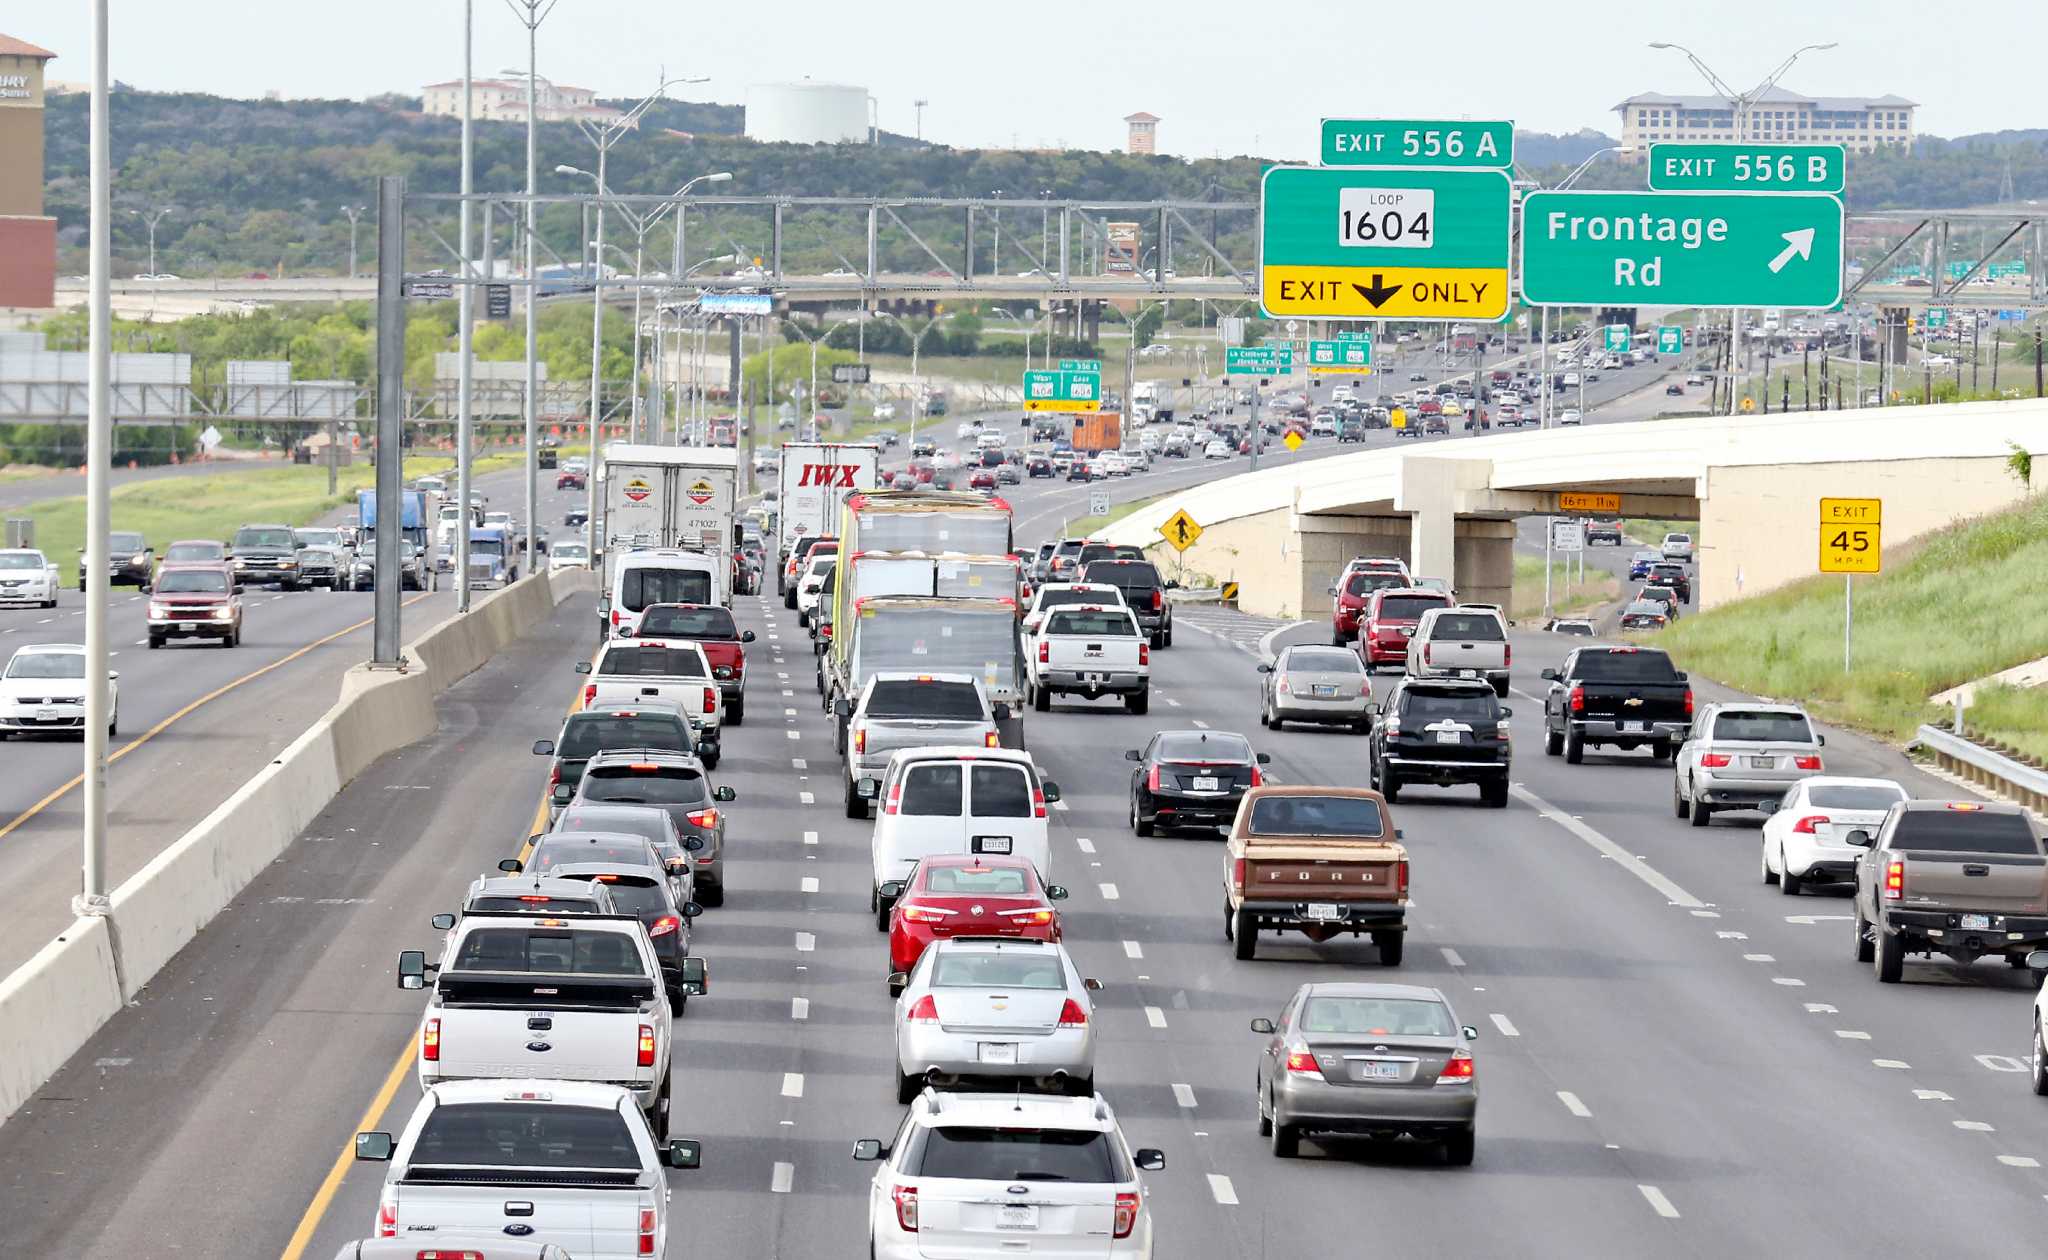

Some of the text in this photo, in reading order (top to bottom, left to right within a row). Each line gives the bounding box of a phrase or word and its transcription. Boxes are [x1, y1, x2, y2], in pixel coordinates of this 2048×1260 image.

[1335, 130, 1498, 158] EXIT 556 A
[1665, 155, 1828, 182] EXIT 556 B
[1370, 194, 1404, 206] LOOP
[1343, 210, 1430, 241] 1604
[1548, 212, 1729, 250] Frontage
[1614, 256, 1662, 287] Rd
[1280, 280, 1489, 303] EXIT ONLY
[798, 464, 861, 488] IWX
[1564, 496, 1575, 506] 16
[1833, 506, 1870, 518] EXIT
[1830, 530, 1869, 552] 45
[1270, 871, 1374, 881] FORD
